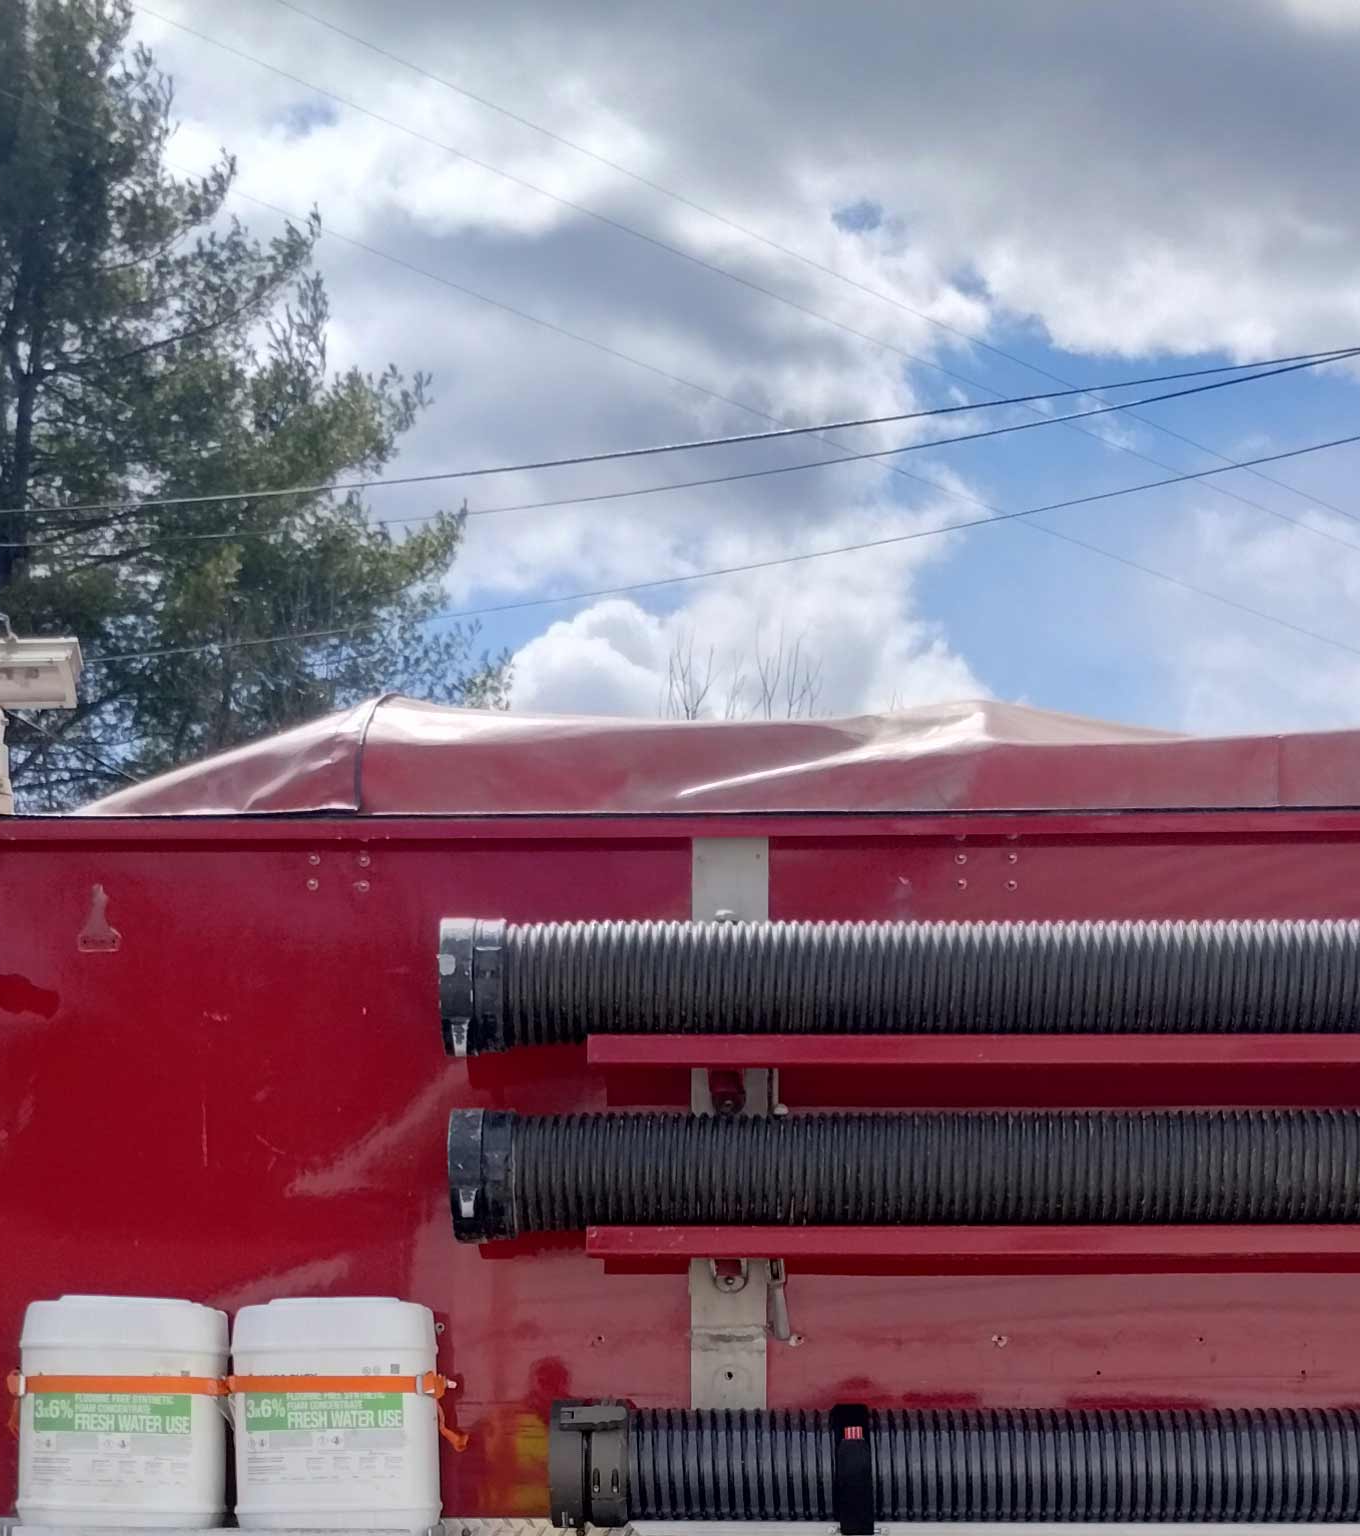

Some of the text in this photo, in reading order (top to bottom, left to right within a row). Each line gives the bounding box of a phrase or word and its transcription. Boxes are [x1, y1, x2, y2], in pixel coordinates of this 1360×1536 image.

[74, 1414, 190, 1434] FRESH WATER USE
[288, 1409, 403, 1428] FRESH WATER USE
